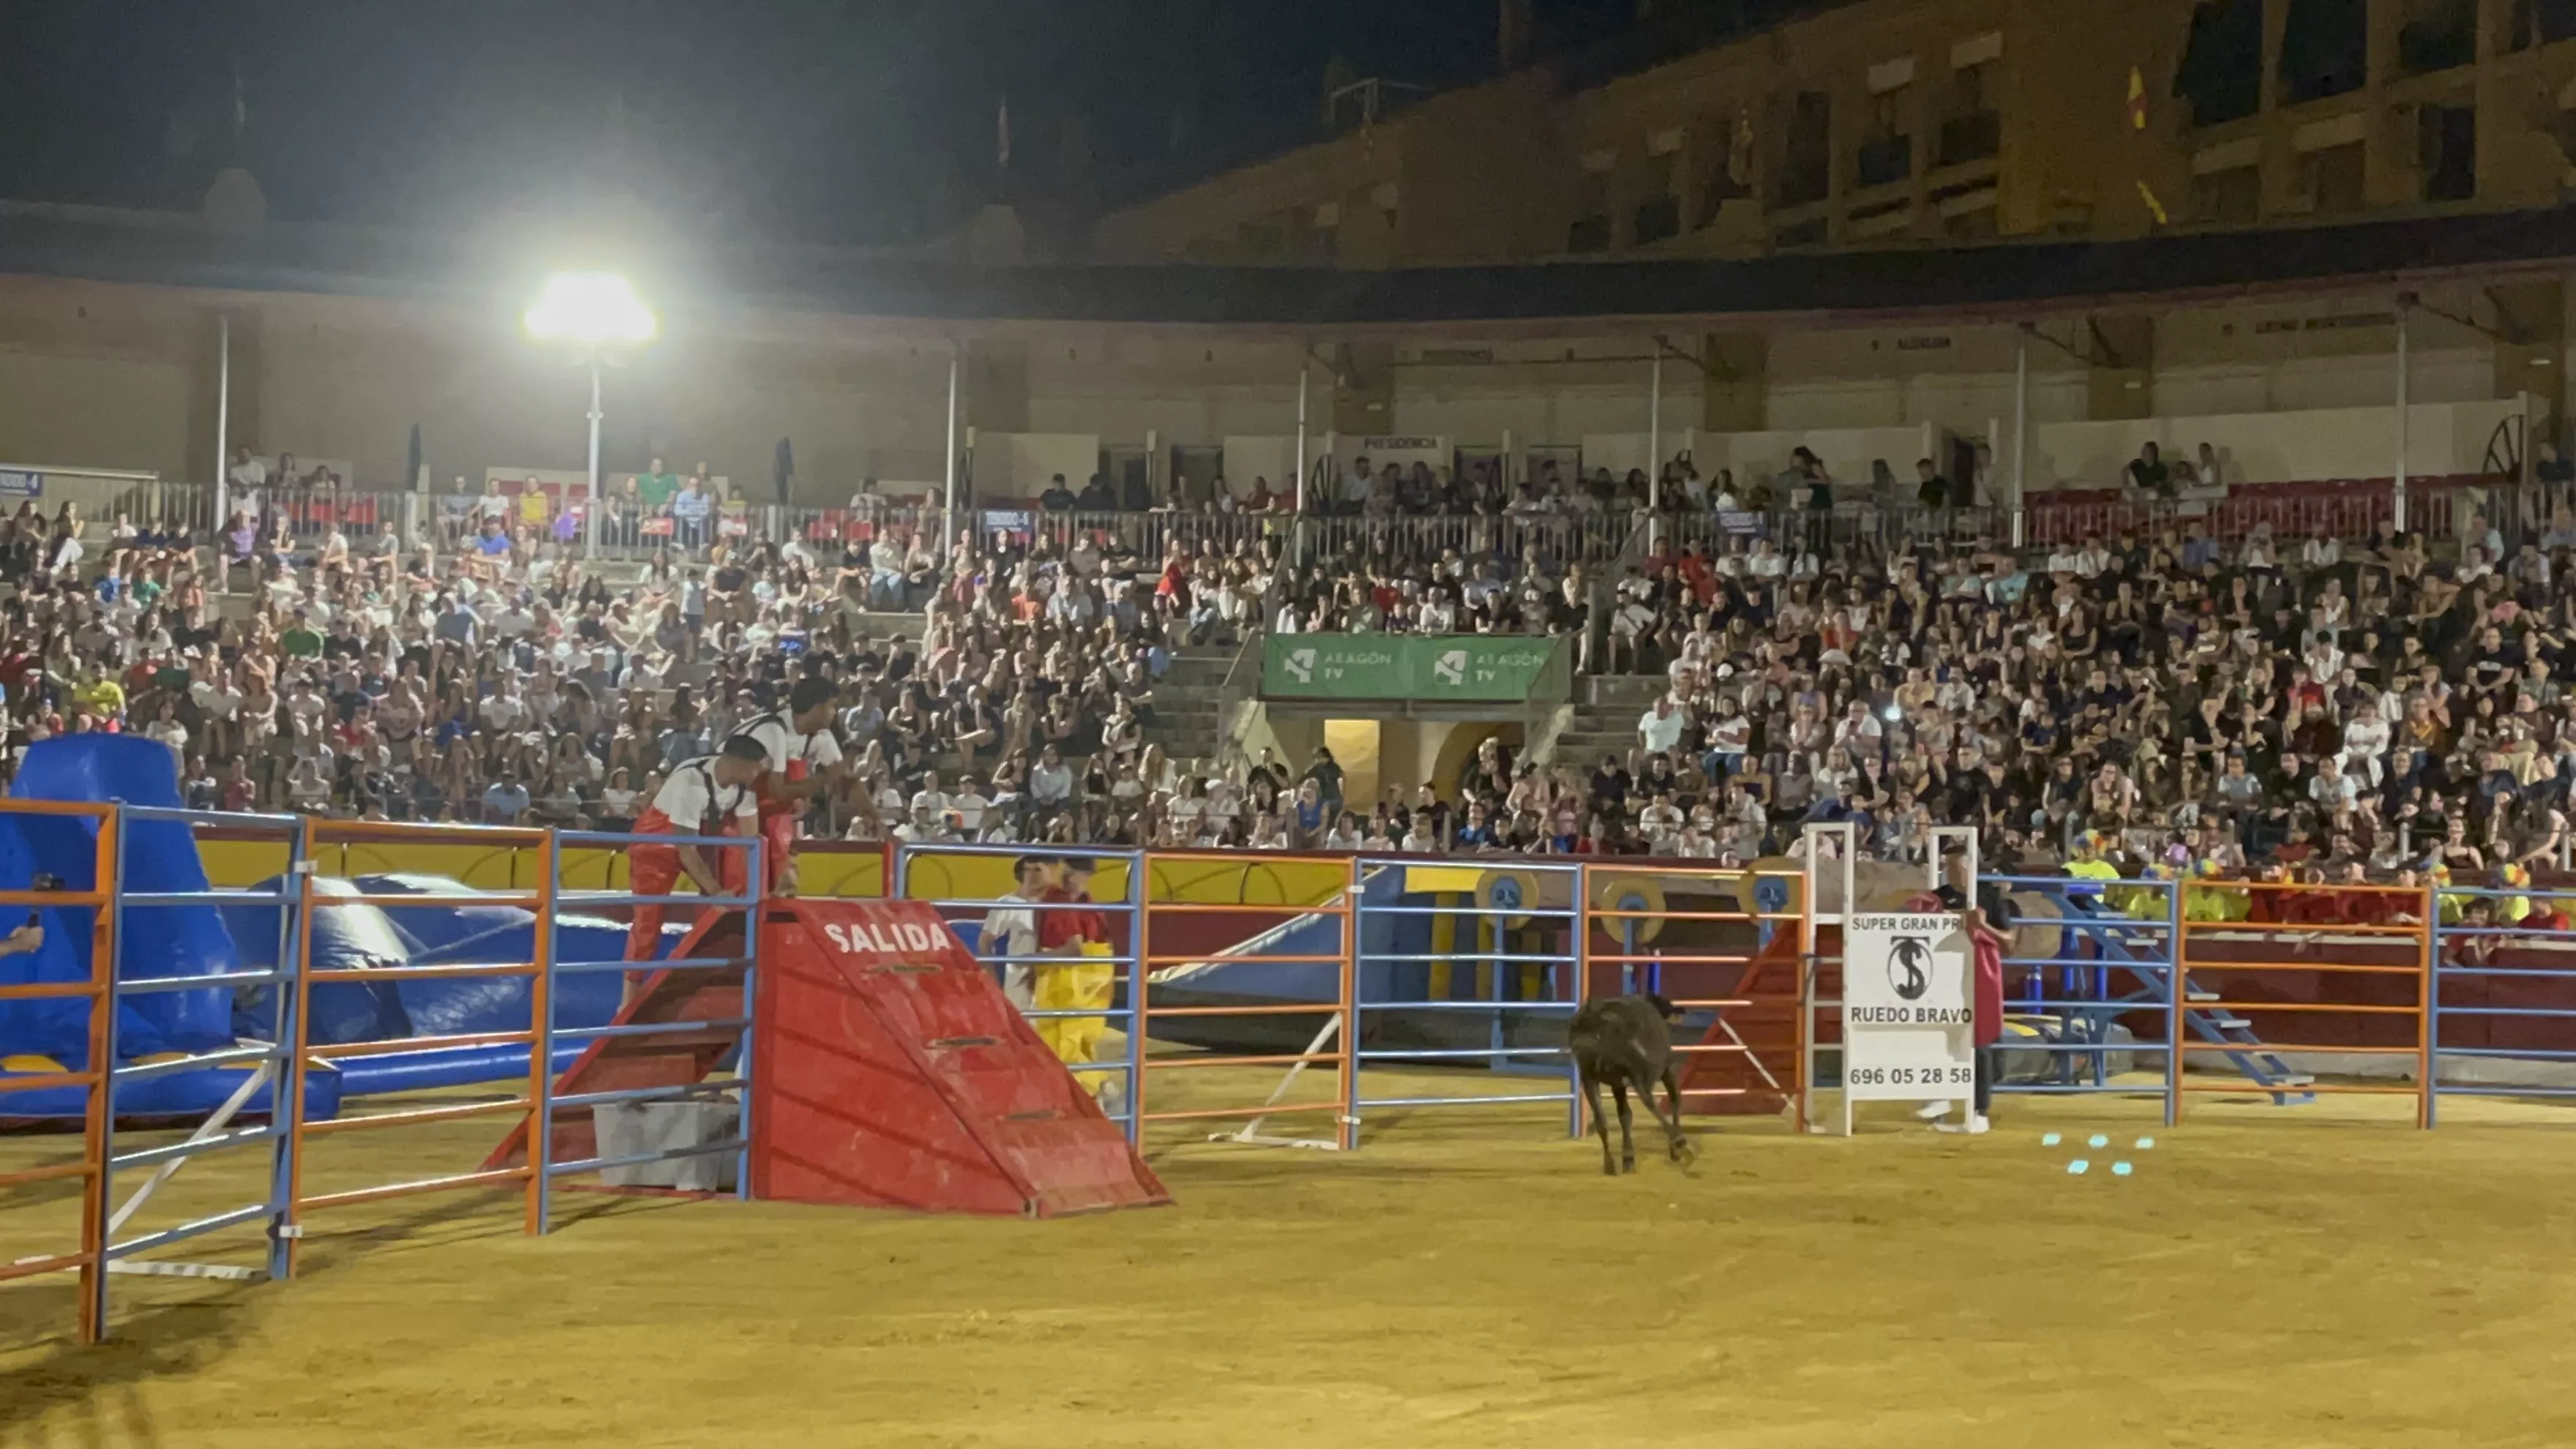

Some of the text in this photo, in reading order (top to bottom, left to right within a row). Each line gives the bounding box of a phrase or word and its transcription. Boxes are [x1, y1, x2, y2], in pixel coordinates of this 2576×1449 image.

[1324, 667, 1344, 680] TV
[1476, 670, 1496, 682] TV
[1852, 917, 1896, 930] SUPER
[1901, 917, 1938, 930] GRAN
[824, 923, 953, 953] SALIDA
[1851, 1007, 1972, 1023] RUEDO BRAVO
[1850, 1068, 1972, 1085] 696 05 28 58
